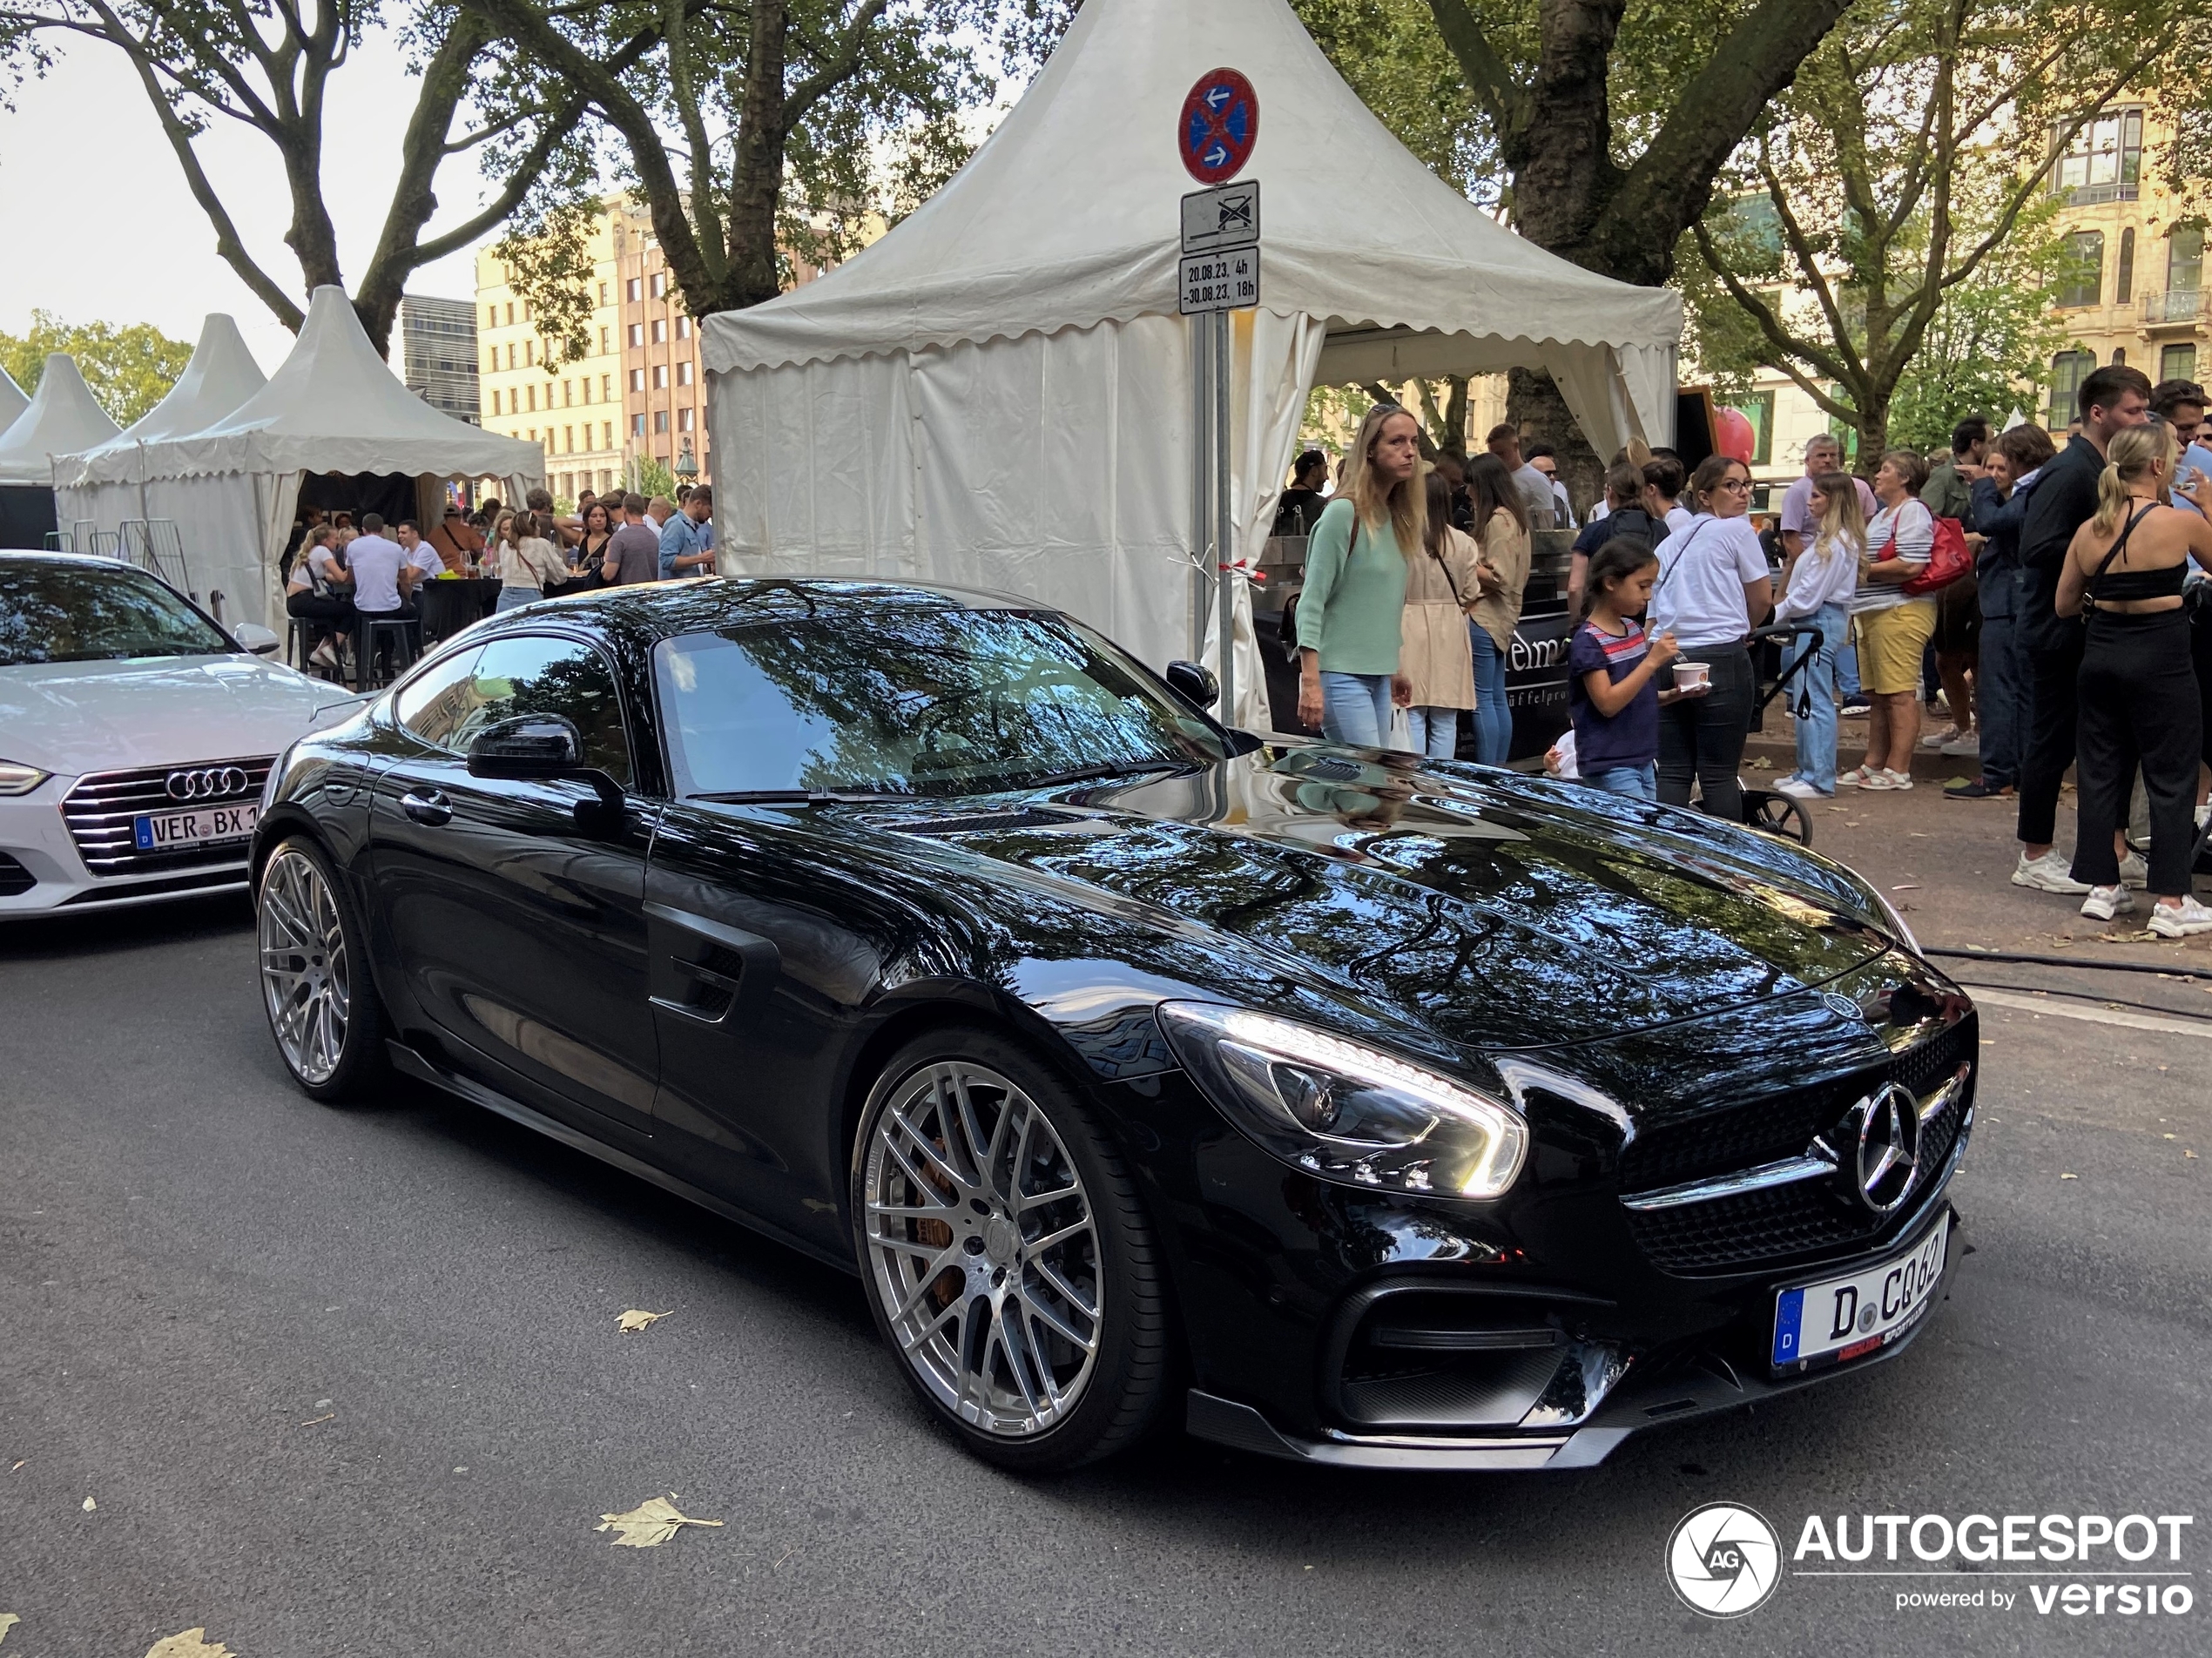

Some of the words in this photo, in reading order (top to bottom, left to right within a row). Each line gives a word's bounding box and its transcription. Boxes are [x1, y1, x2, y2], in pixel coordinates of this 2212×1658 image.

[1236, 259, 1248, 275] 4h
[1237, 280, 1254, 297] 18h
[152, 816, 198, 842] VER
[214, 810, 242, 834] BX
[1830, 1285, 1858, 1340] D
[1783, 1333, 1792, 1349] D
